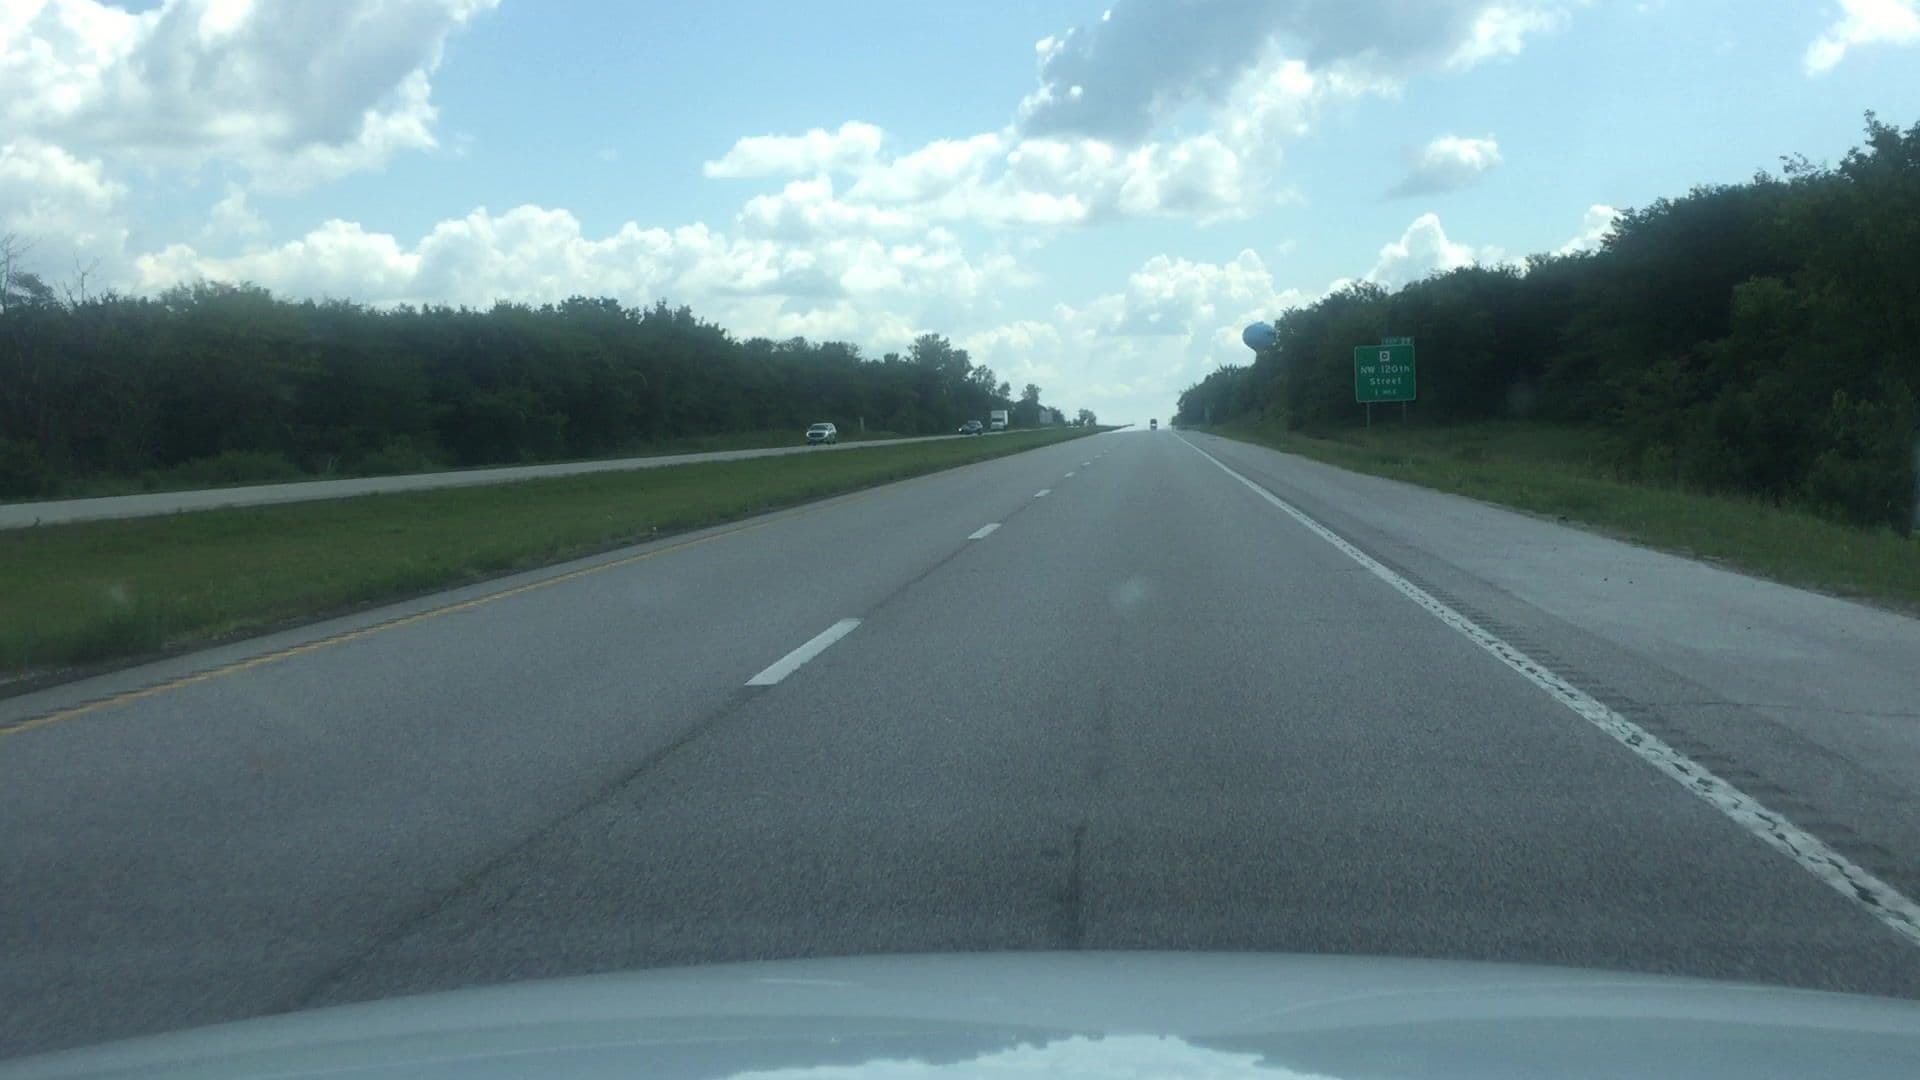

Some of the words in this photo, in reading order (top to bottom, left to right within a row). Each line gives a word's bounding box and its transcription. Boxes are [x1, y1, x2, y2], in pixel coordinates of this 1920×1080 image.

[1360, 366, 1375, 374] NW
[1381, 364, 1410, 374] 120th
[1369, 377, 1401, 385] Street
